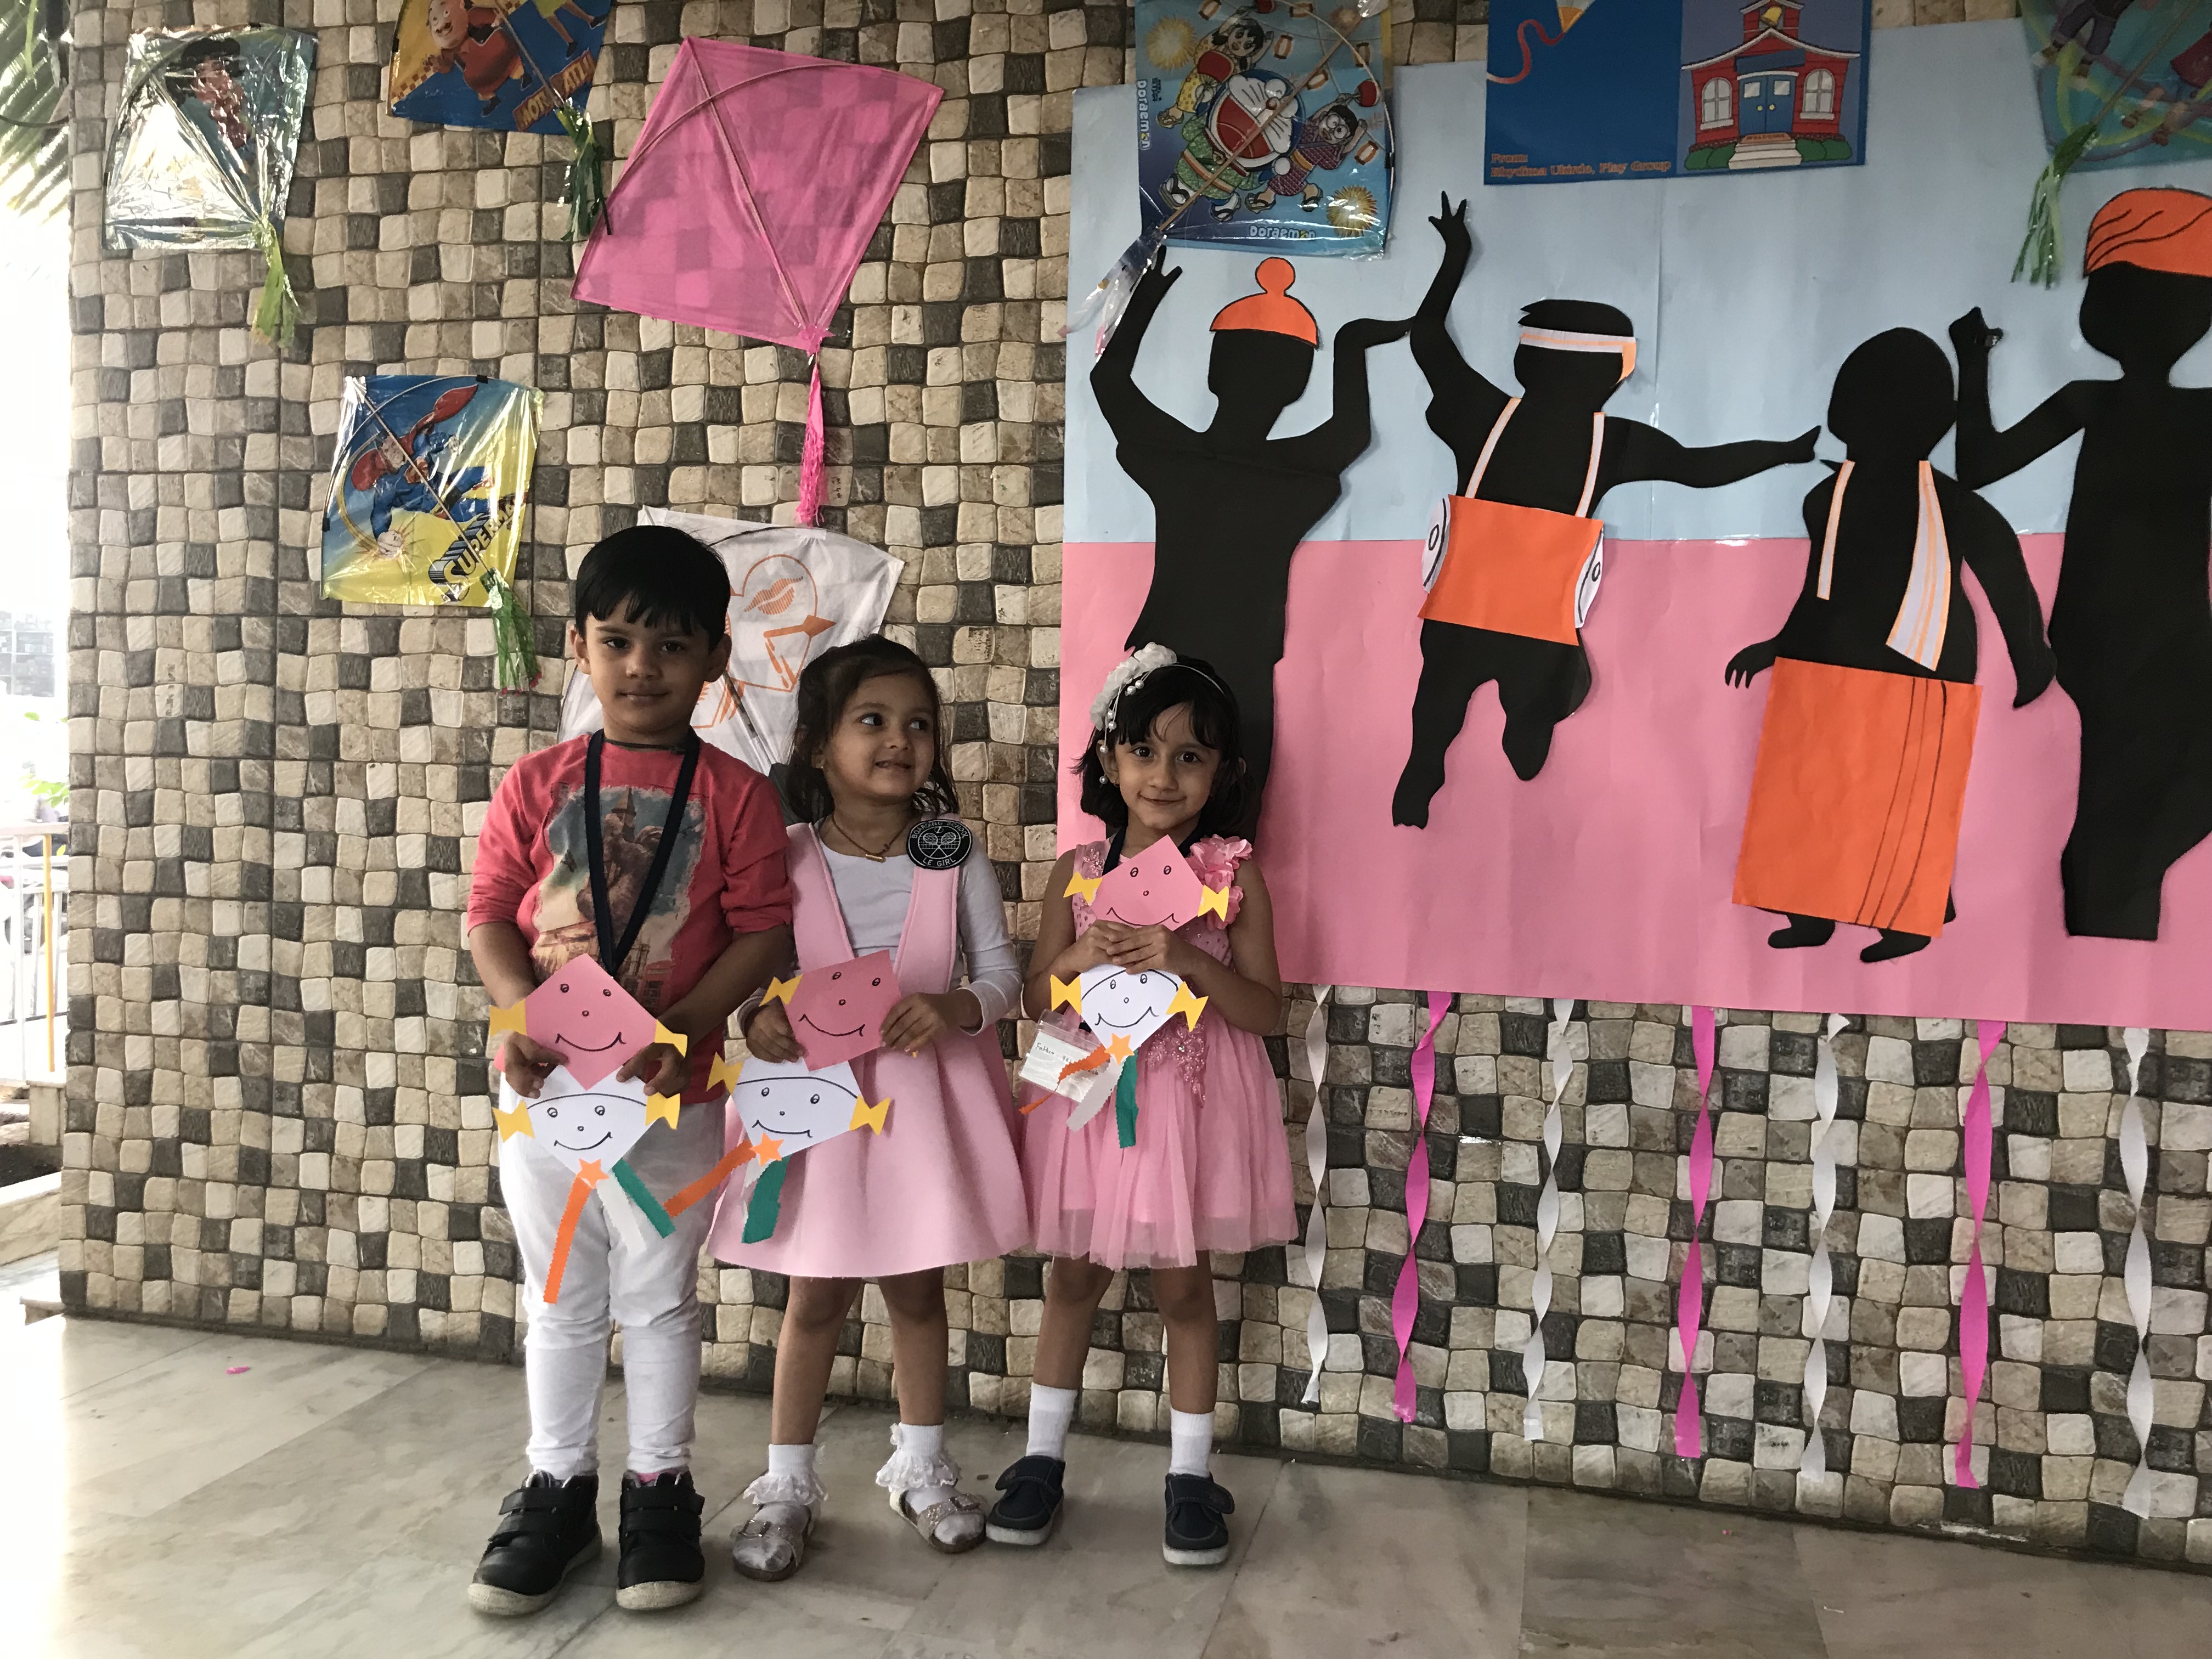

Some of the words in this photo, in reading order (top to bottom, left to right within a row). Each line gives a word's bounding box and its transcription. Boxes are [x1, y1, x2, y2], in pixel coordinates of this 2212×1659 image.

[1137, 80, 1150, 148] Doraemon
[1600, 162, 1628, 174] Play
[1631, 161, 1671, 172] Group
[1250, 225, 1316, 240] Doraemon
[911, 822, 943, 838] BOARDING
[946, 822, 968, 838] SCHOOL
[922, 857, 933, 866] LE
[936, 857, 956, 867] GIRL
